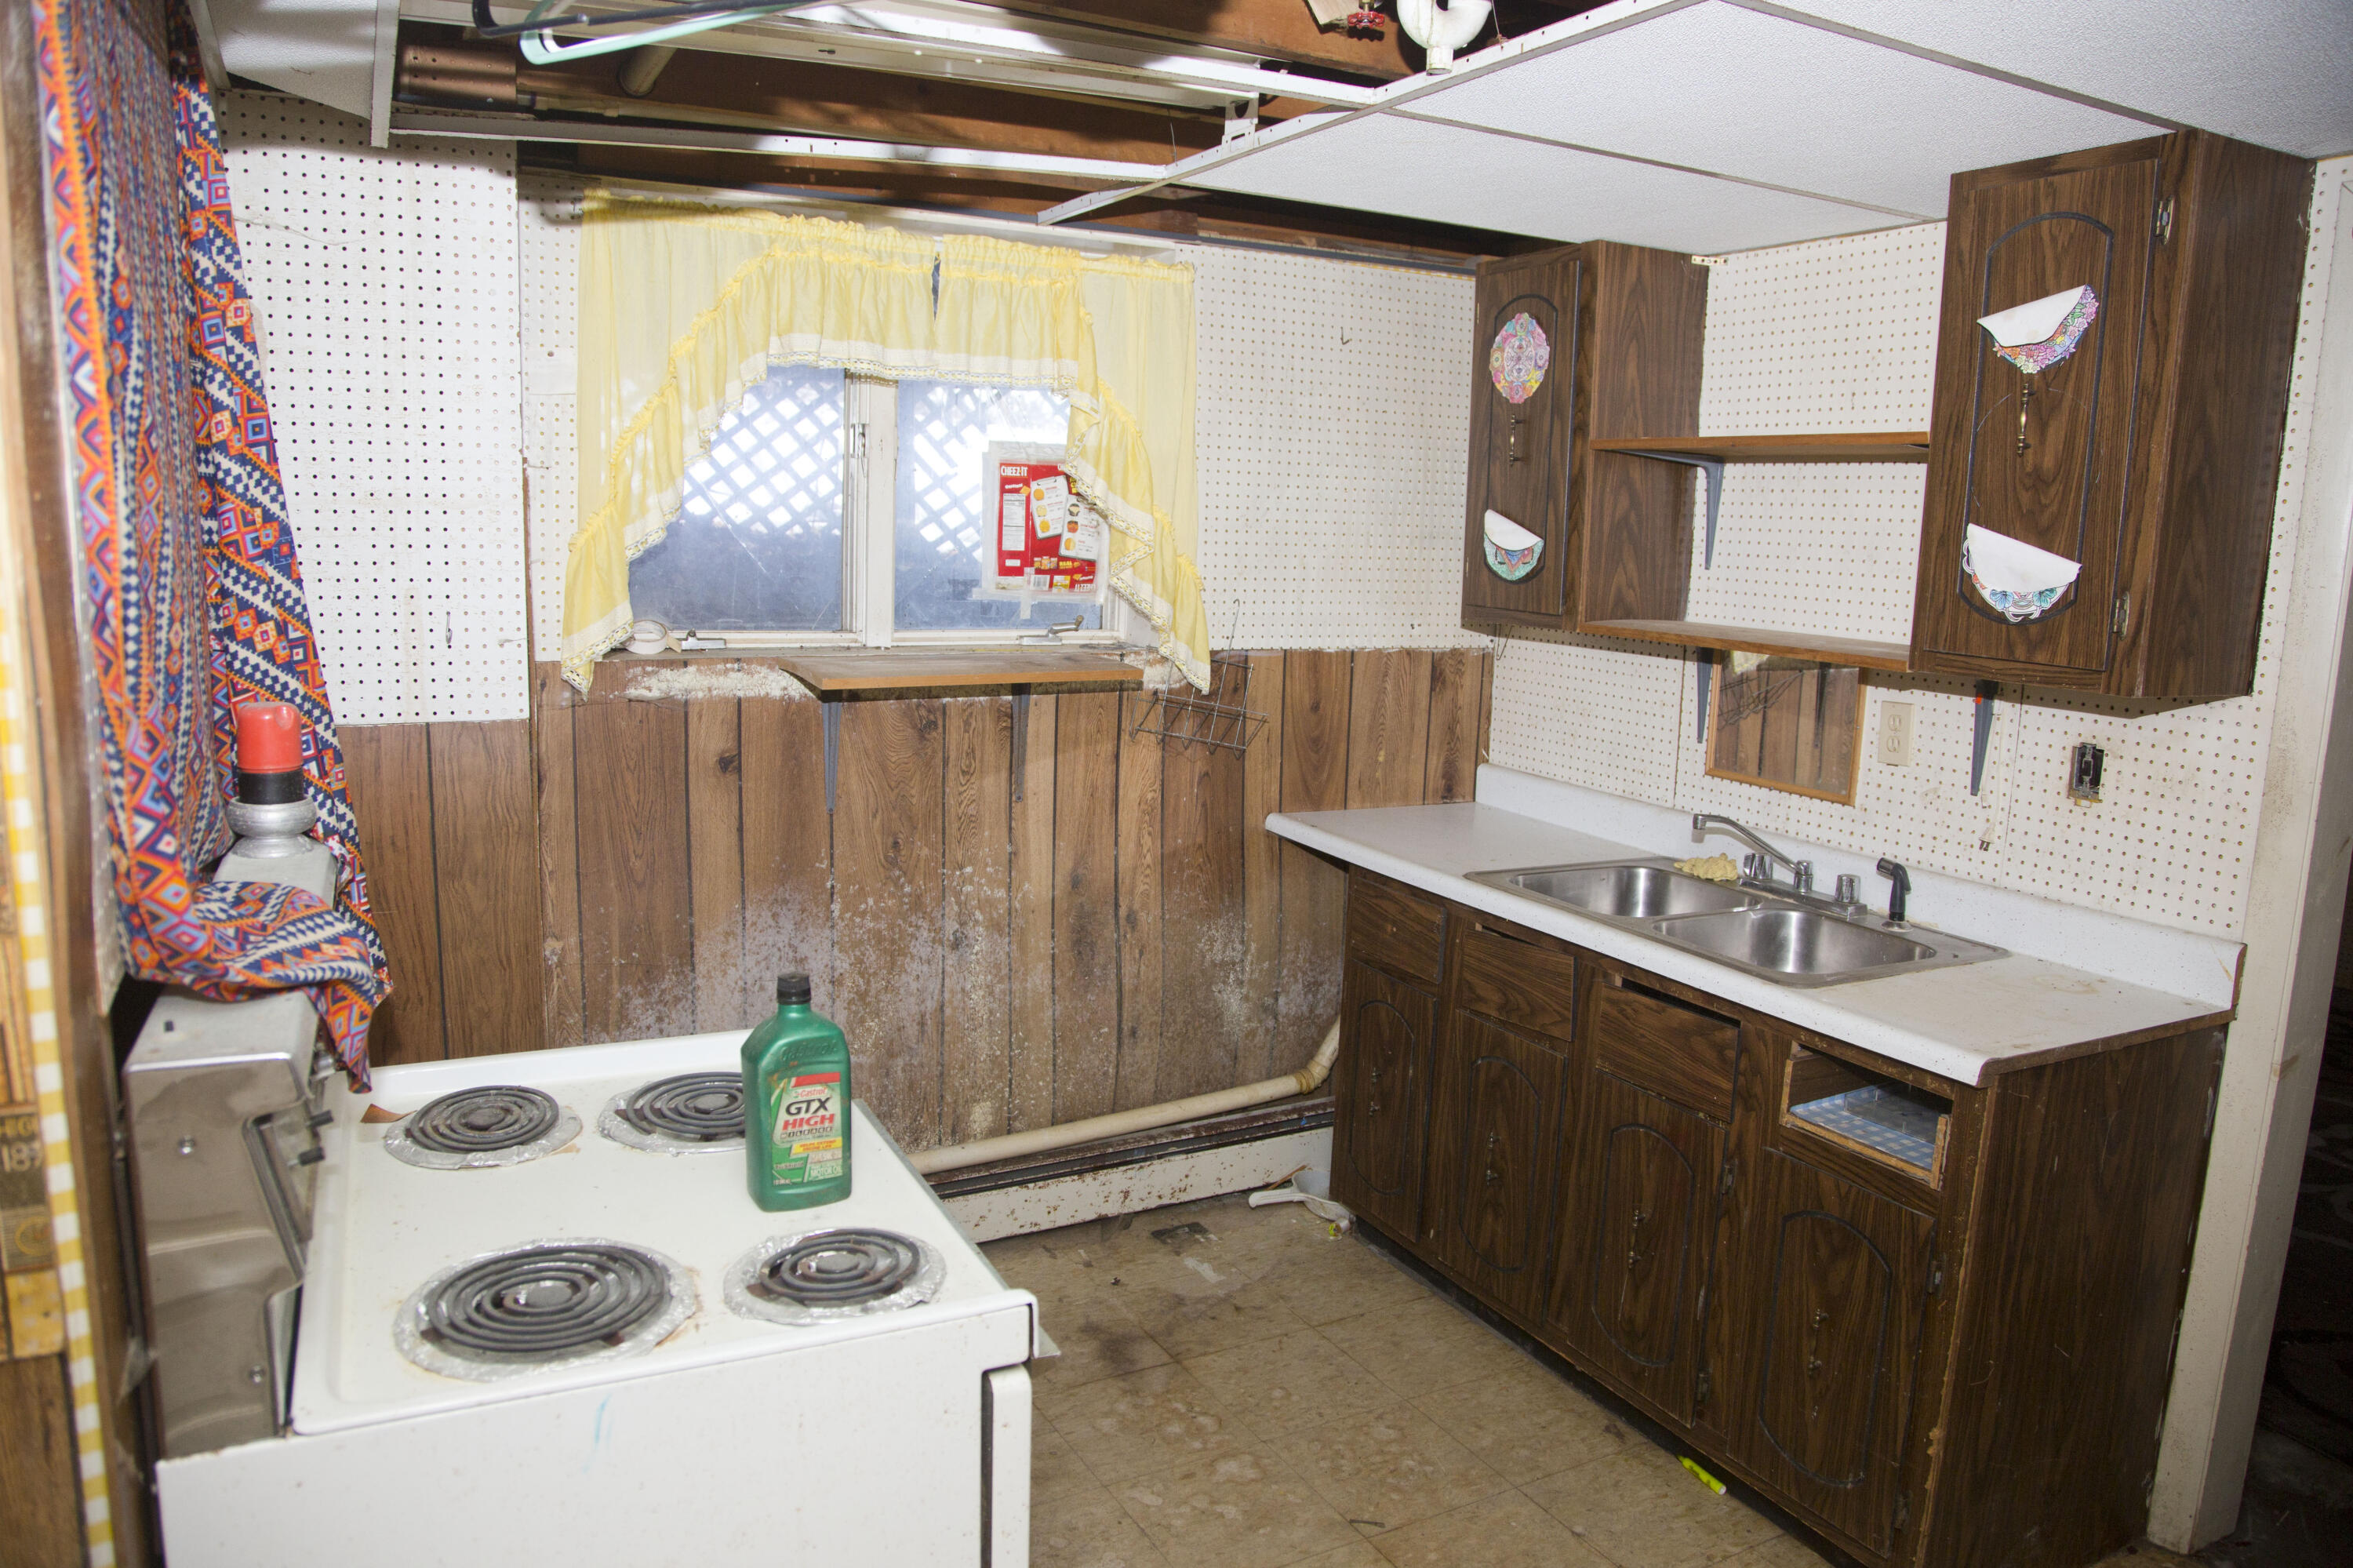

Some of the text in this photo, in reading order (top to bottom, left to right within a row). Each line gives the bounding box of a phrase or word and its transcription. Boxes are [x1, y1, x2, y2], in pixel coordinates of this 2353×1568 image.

[800, 1087, 827, 1097] Castrol
[785, 1097, 832, 1115] GTX
[782, 1113, 835, 1131] HIGH
[810, 1166, 833, 1176] MOTOR
